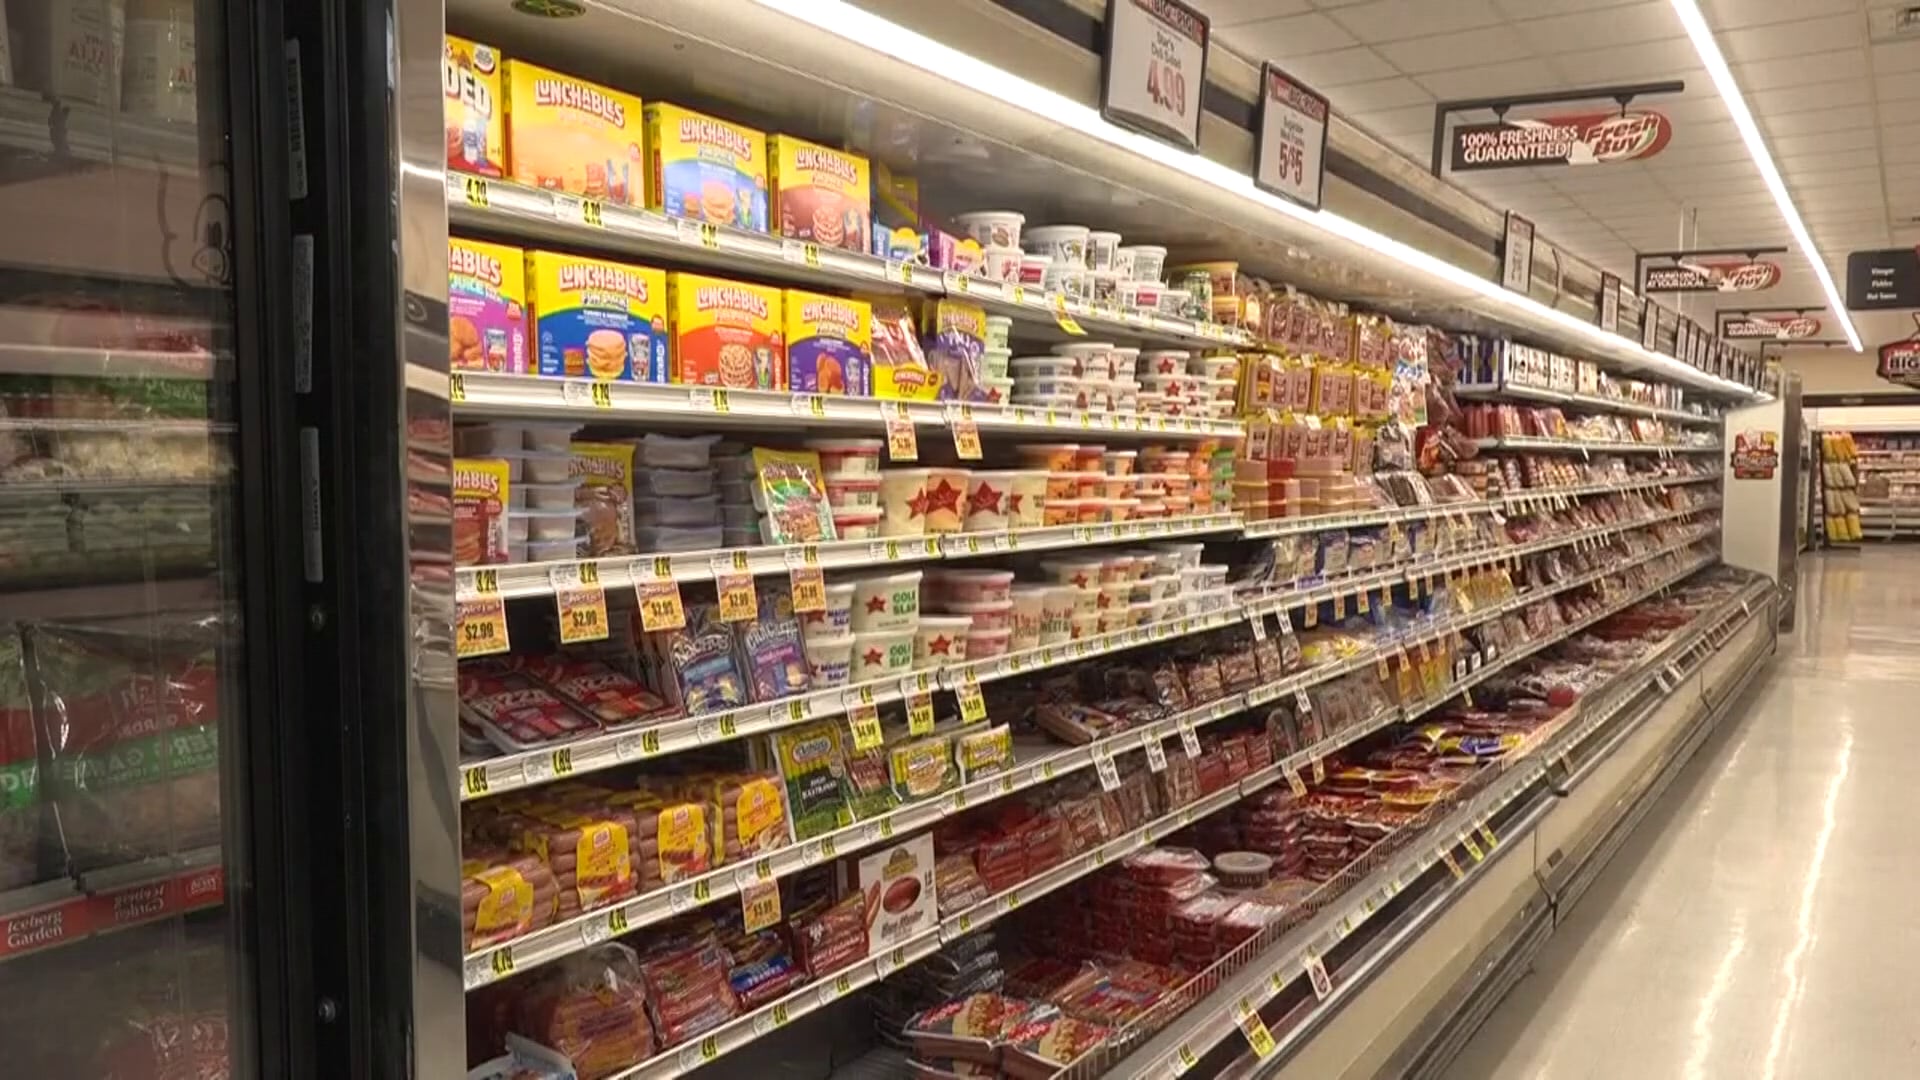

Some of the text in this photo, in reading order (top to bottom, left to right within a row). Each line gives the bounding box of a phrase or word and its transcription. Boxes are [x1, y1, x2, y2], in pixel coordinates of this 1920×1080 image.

[535, 79, 625, 128] LUNCHABLES
[680, 119, 752, 161] LUNCHABLES
[1460, 124, 1578, 149] 100% FRESHNESS
[1585, 114, 1660, 146] Fresh
[796, 148, 858, 185] LUNCHABLES
[559, 264, 649, 303] LUNCHABLES
[697, 287, 768, 319] LUNCHABLES
[572, 610, 597, 626] $2.99
[465, 623, 494, 641] $2.99
[552, 748, 572, 774] 1.89
[465, 767, 488, 794] 1.89
[8, 911, 62, 935] Iceberg
[8, 926, 62, 948] Garden
